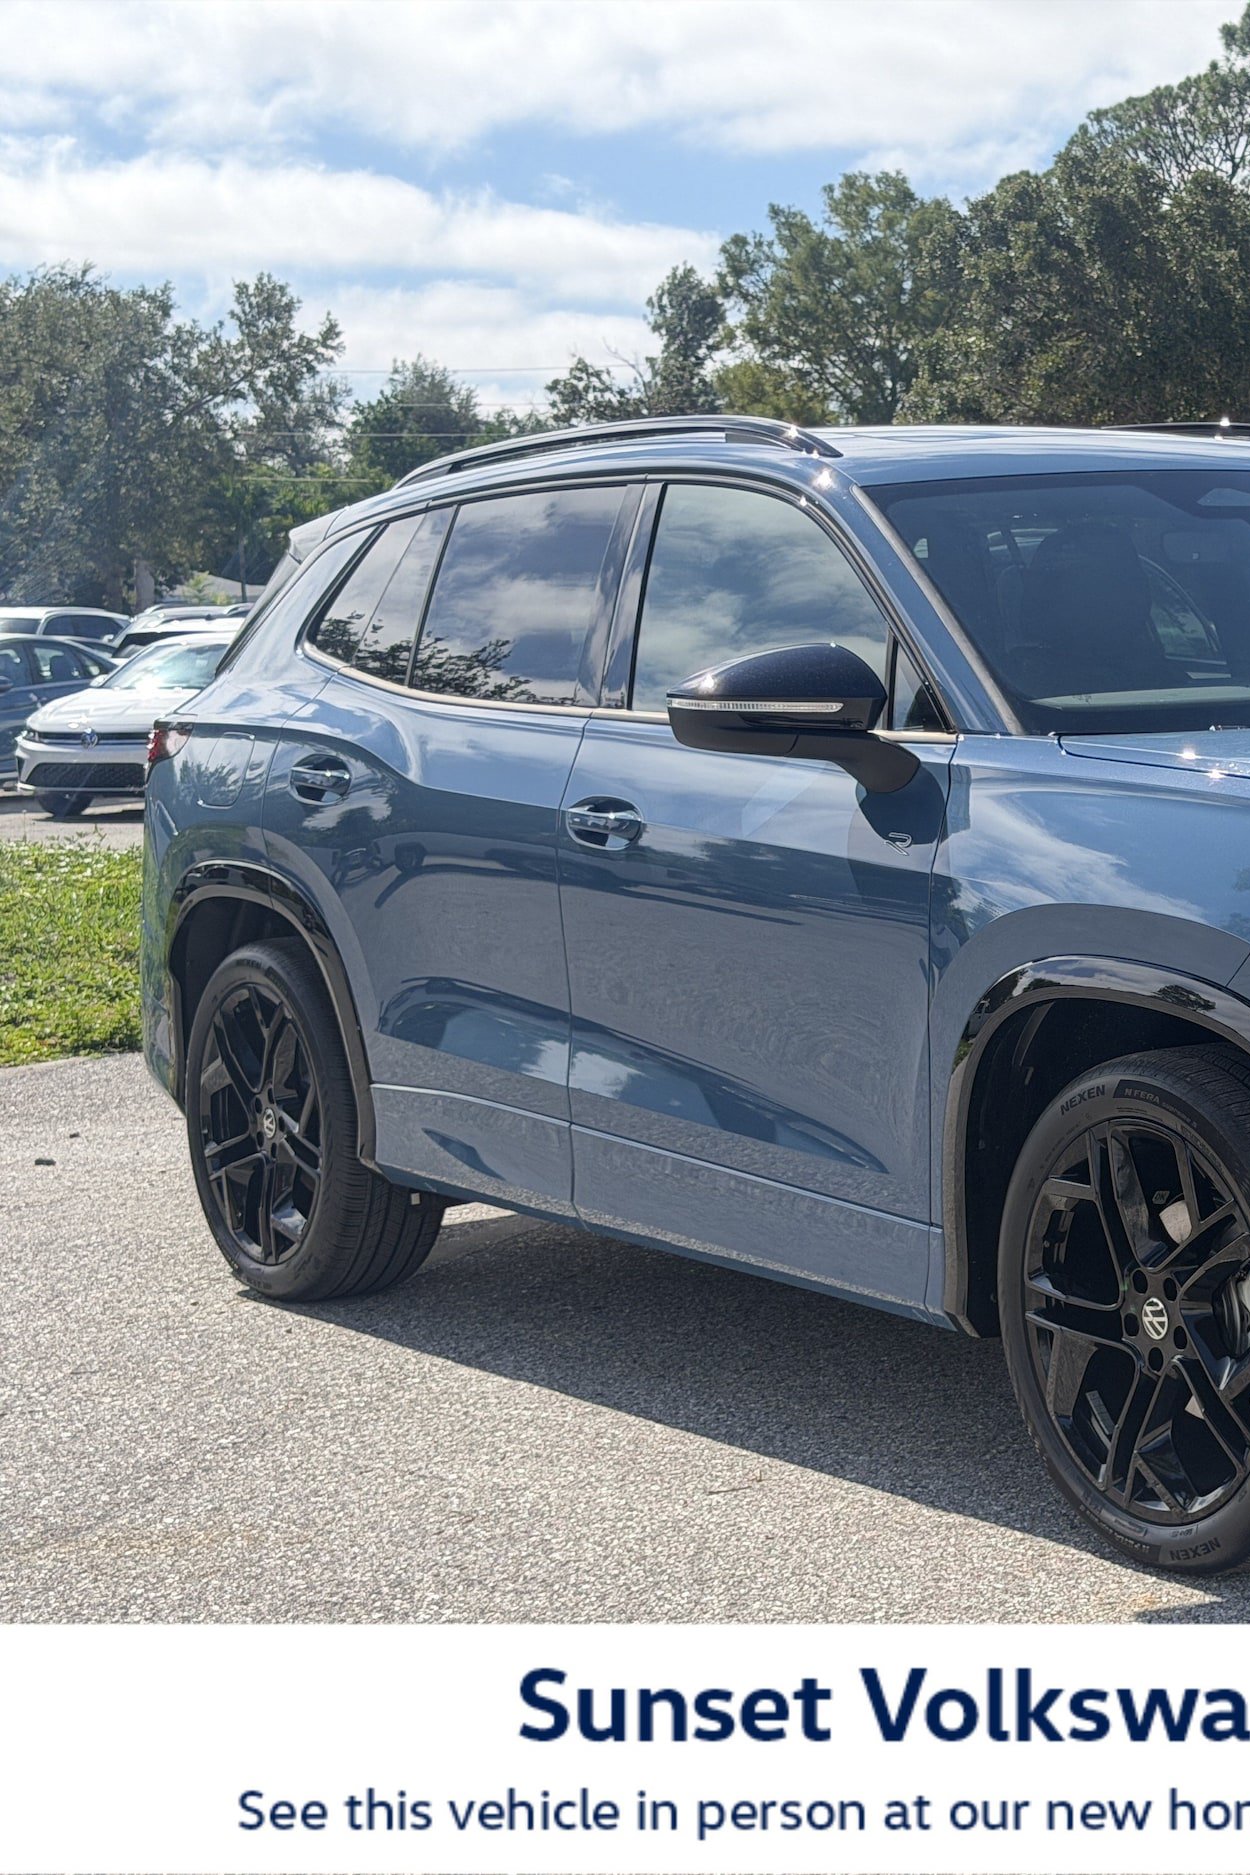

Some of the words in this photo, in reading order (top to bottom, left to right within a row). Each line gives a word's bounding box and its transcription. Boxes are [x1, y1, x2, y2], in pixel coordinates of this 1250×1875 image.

[884, 832, 912, 856] R
[1060, 1084, 1106, 1116] NEXEN
[1133, 1089, 1161, 1104] FERA
[1169, 1537, 1222, 1562] NEXEN
